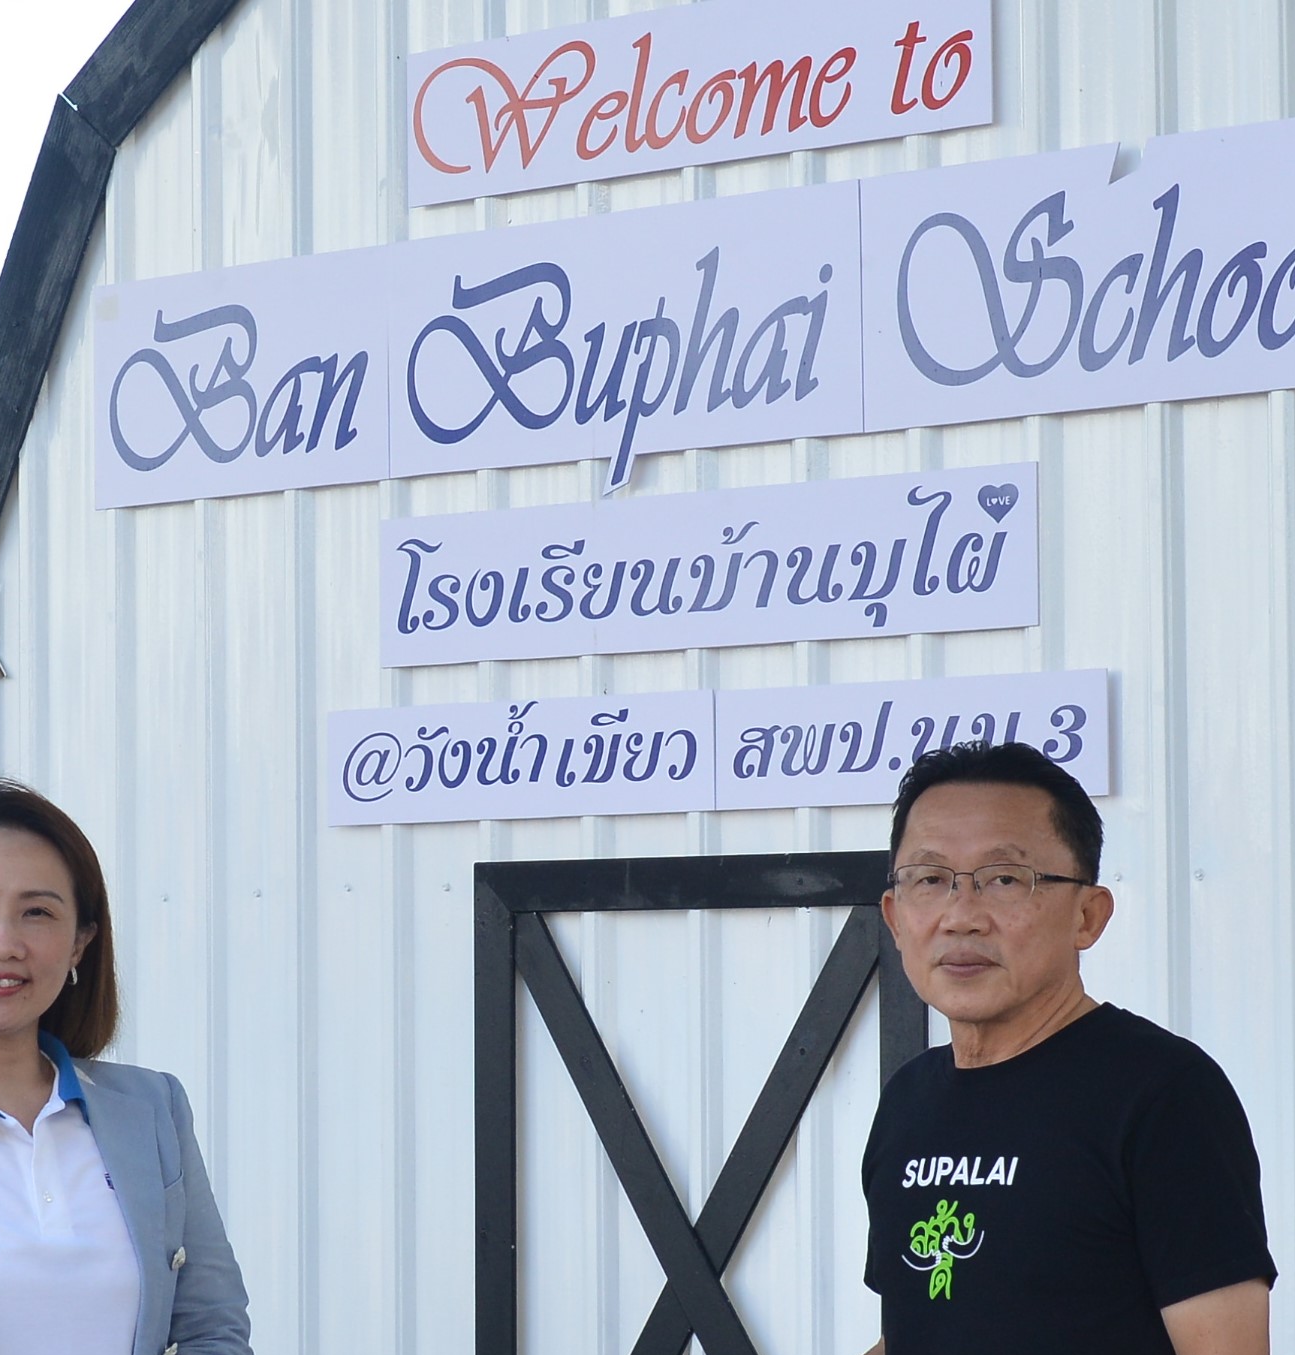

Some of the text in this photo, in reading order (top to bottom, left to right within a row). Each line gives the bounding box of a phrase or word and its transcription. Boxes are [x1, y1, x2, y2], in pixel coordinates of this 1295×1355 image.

[412, 20, 974, 175] Welcome to
[108, 303, 371, 474] Ban
[406, 246, 835, 489] Buphai
[341, 700, 698, 803] @วังน้ำเขียว
[902, 1156, 1019, 1188] SUPALAI
